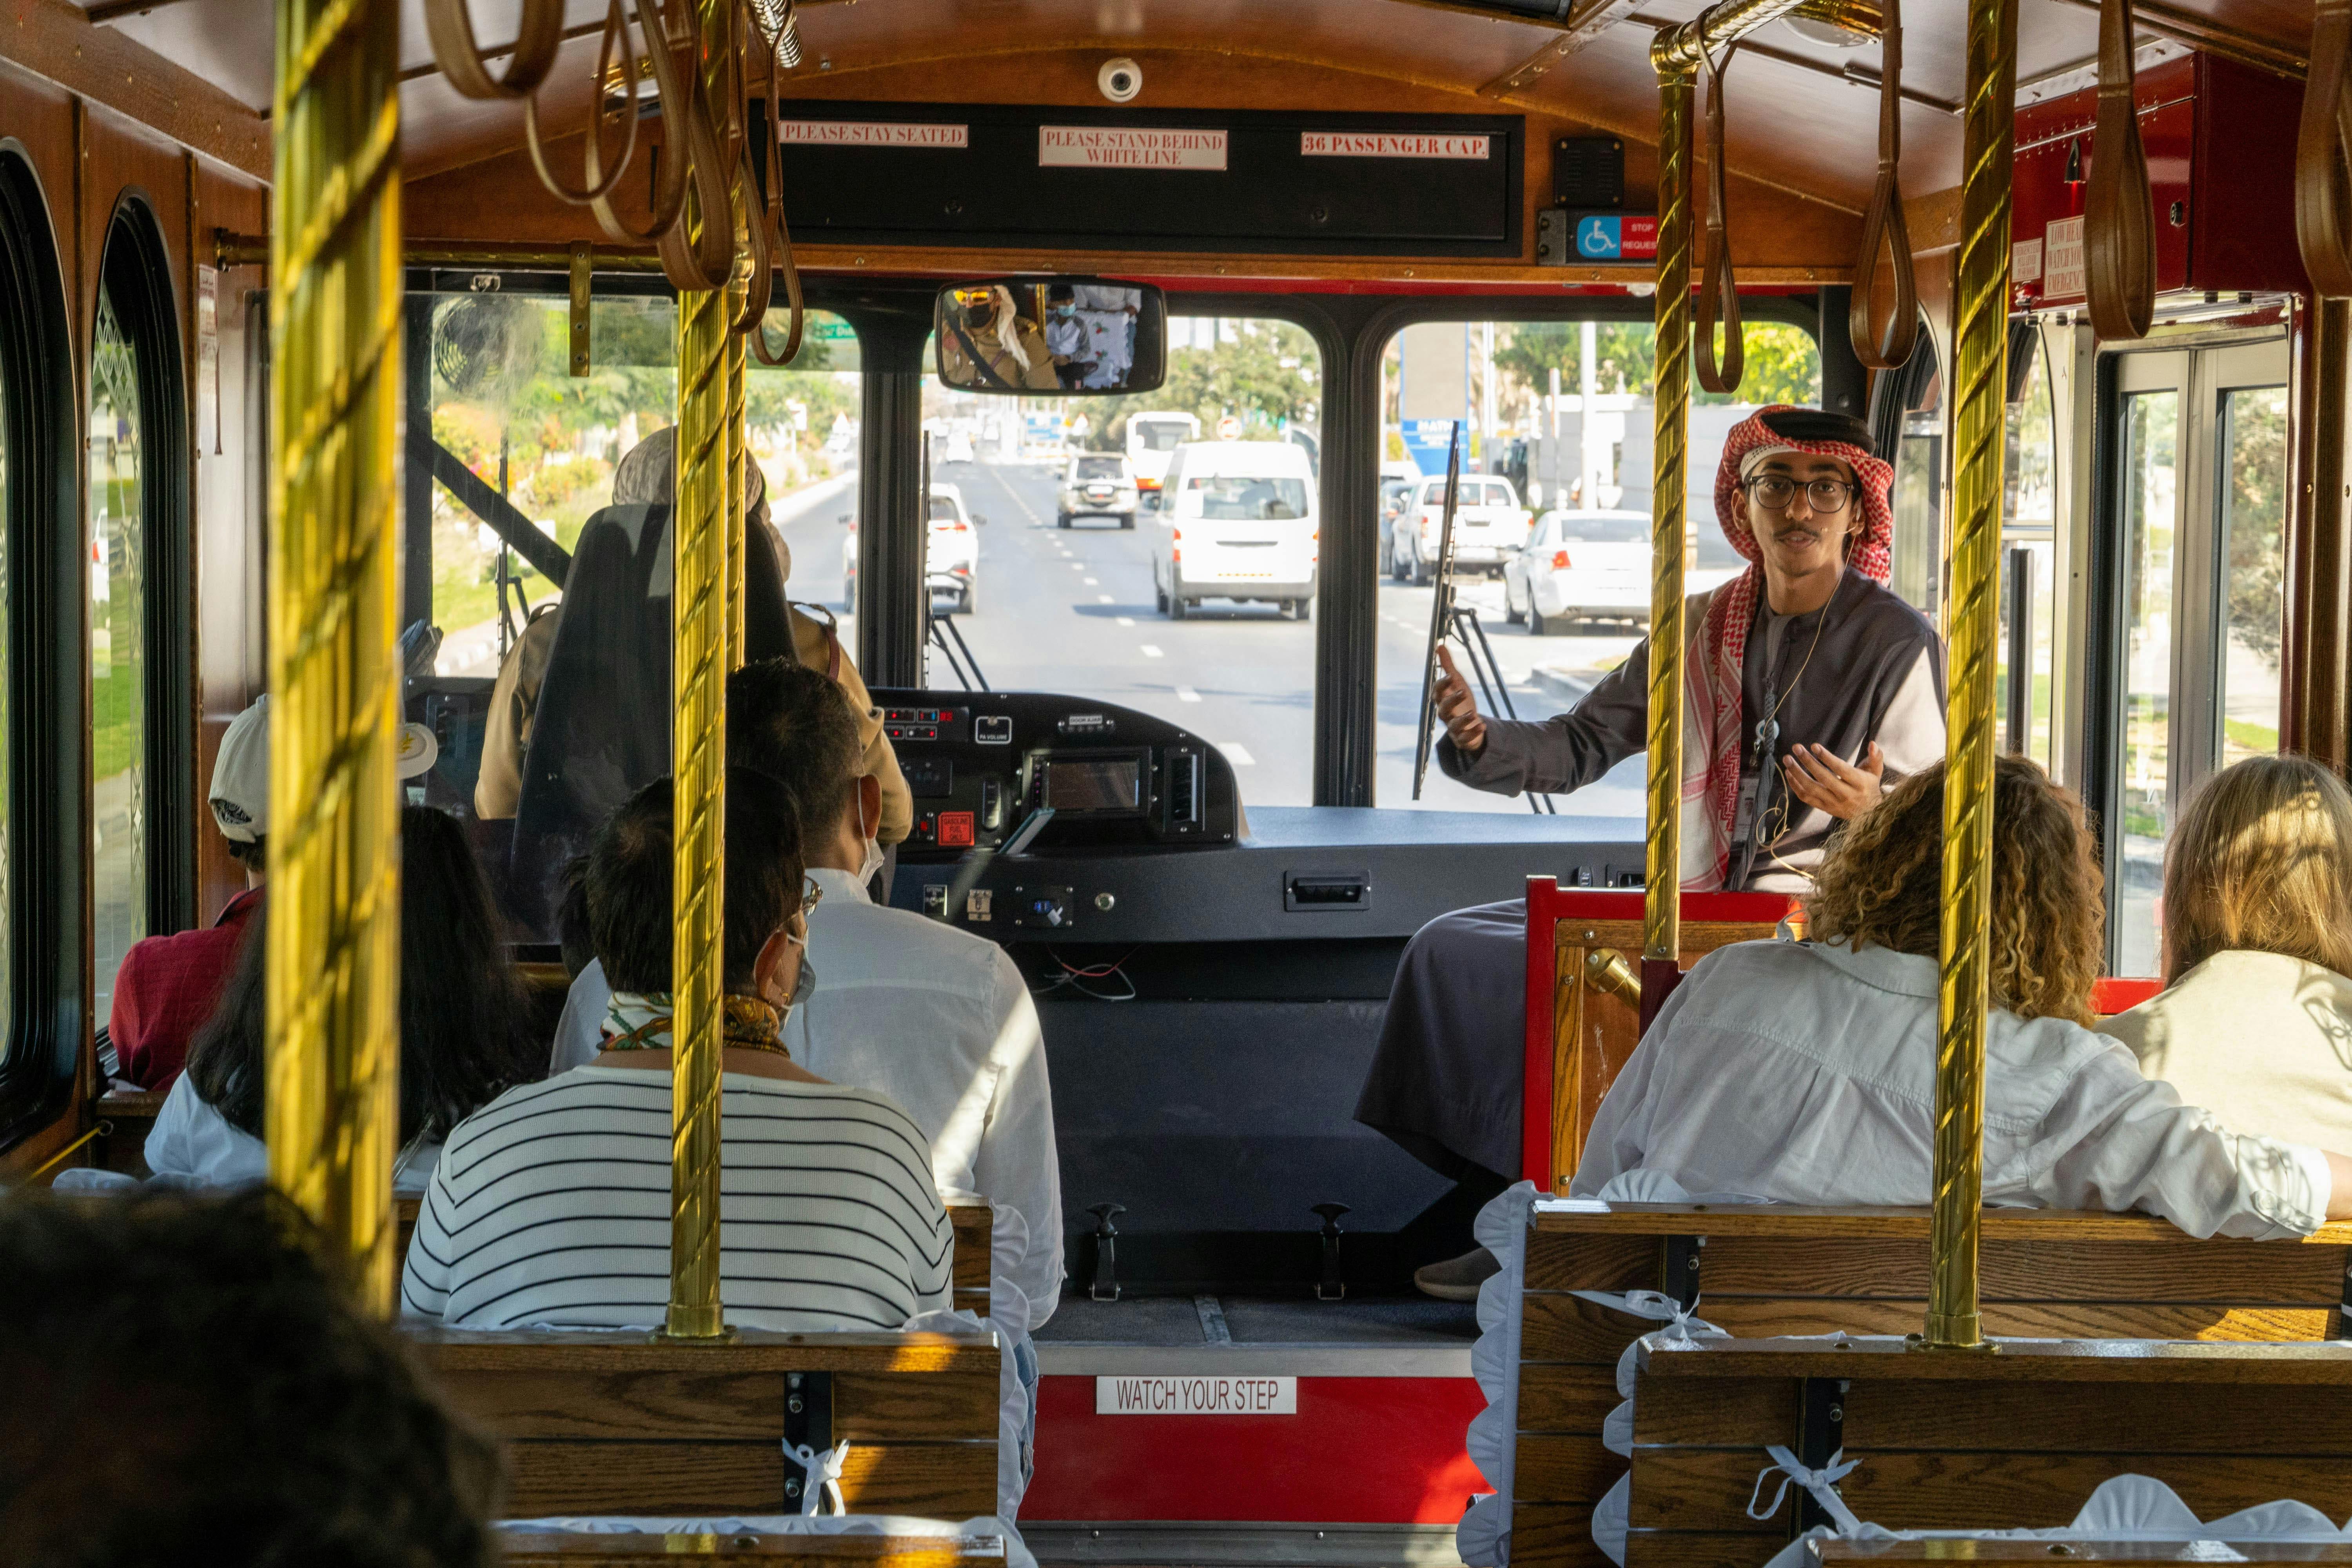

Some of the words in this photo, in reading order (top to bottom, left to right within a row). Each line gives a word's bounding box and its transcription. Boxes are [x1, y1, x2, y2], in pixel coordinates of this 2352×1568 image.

[785, 124, 849, 141] PLEASE
[851, 126, 893, 143] STAY
[897, 128, 963, 143] SEATED
[1046, 131, 1105, 147] PLEASE
[1107, 133, 1158, 149] STAND
[1162, 134, 1223, 150] BEHIND
[1305, 136, 1326, 152] 36
[1332, 136, 1439, 154] PASSENGER
[1445, 139, 1485, 155] CAP.
[1086, 149, 1142, 164] WHITE
[1143, 151, 1181, 165] LINE
[1631, 223, 1654, 232] STOP
[1622, 241, 1657, 249] REQUES
[1117, 1380, 1176, 1410] WATCH
[1181, 1380, 1230, 1410] YOUR
[1234, 1380, 1279, 1410] STEP
